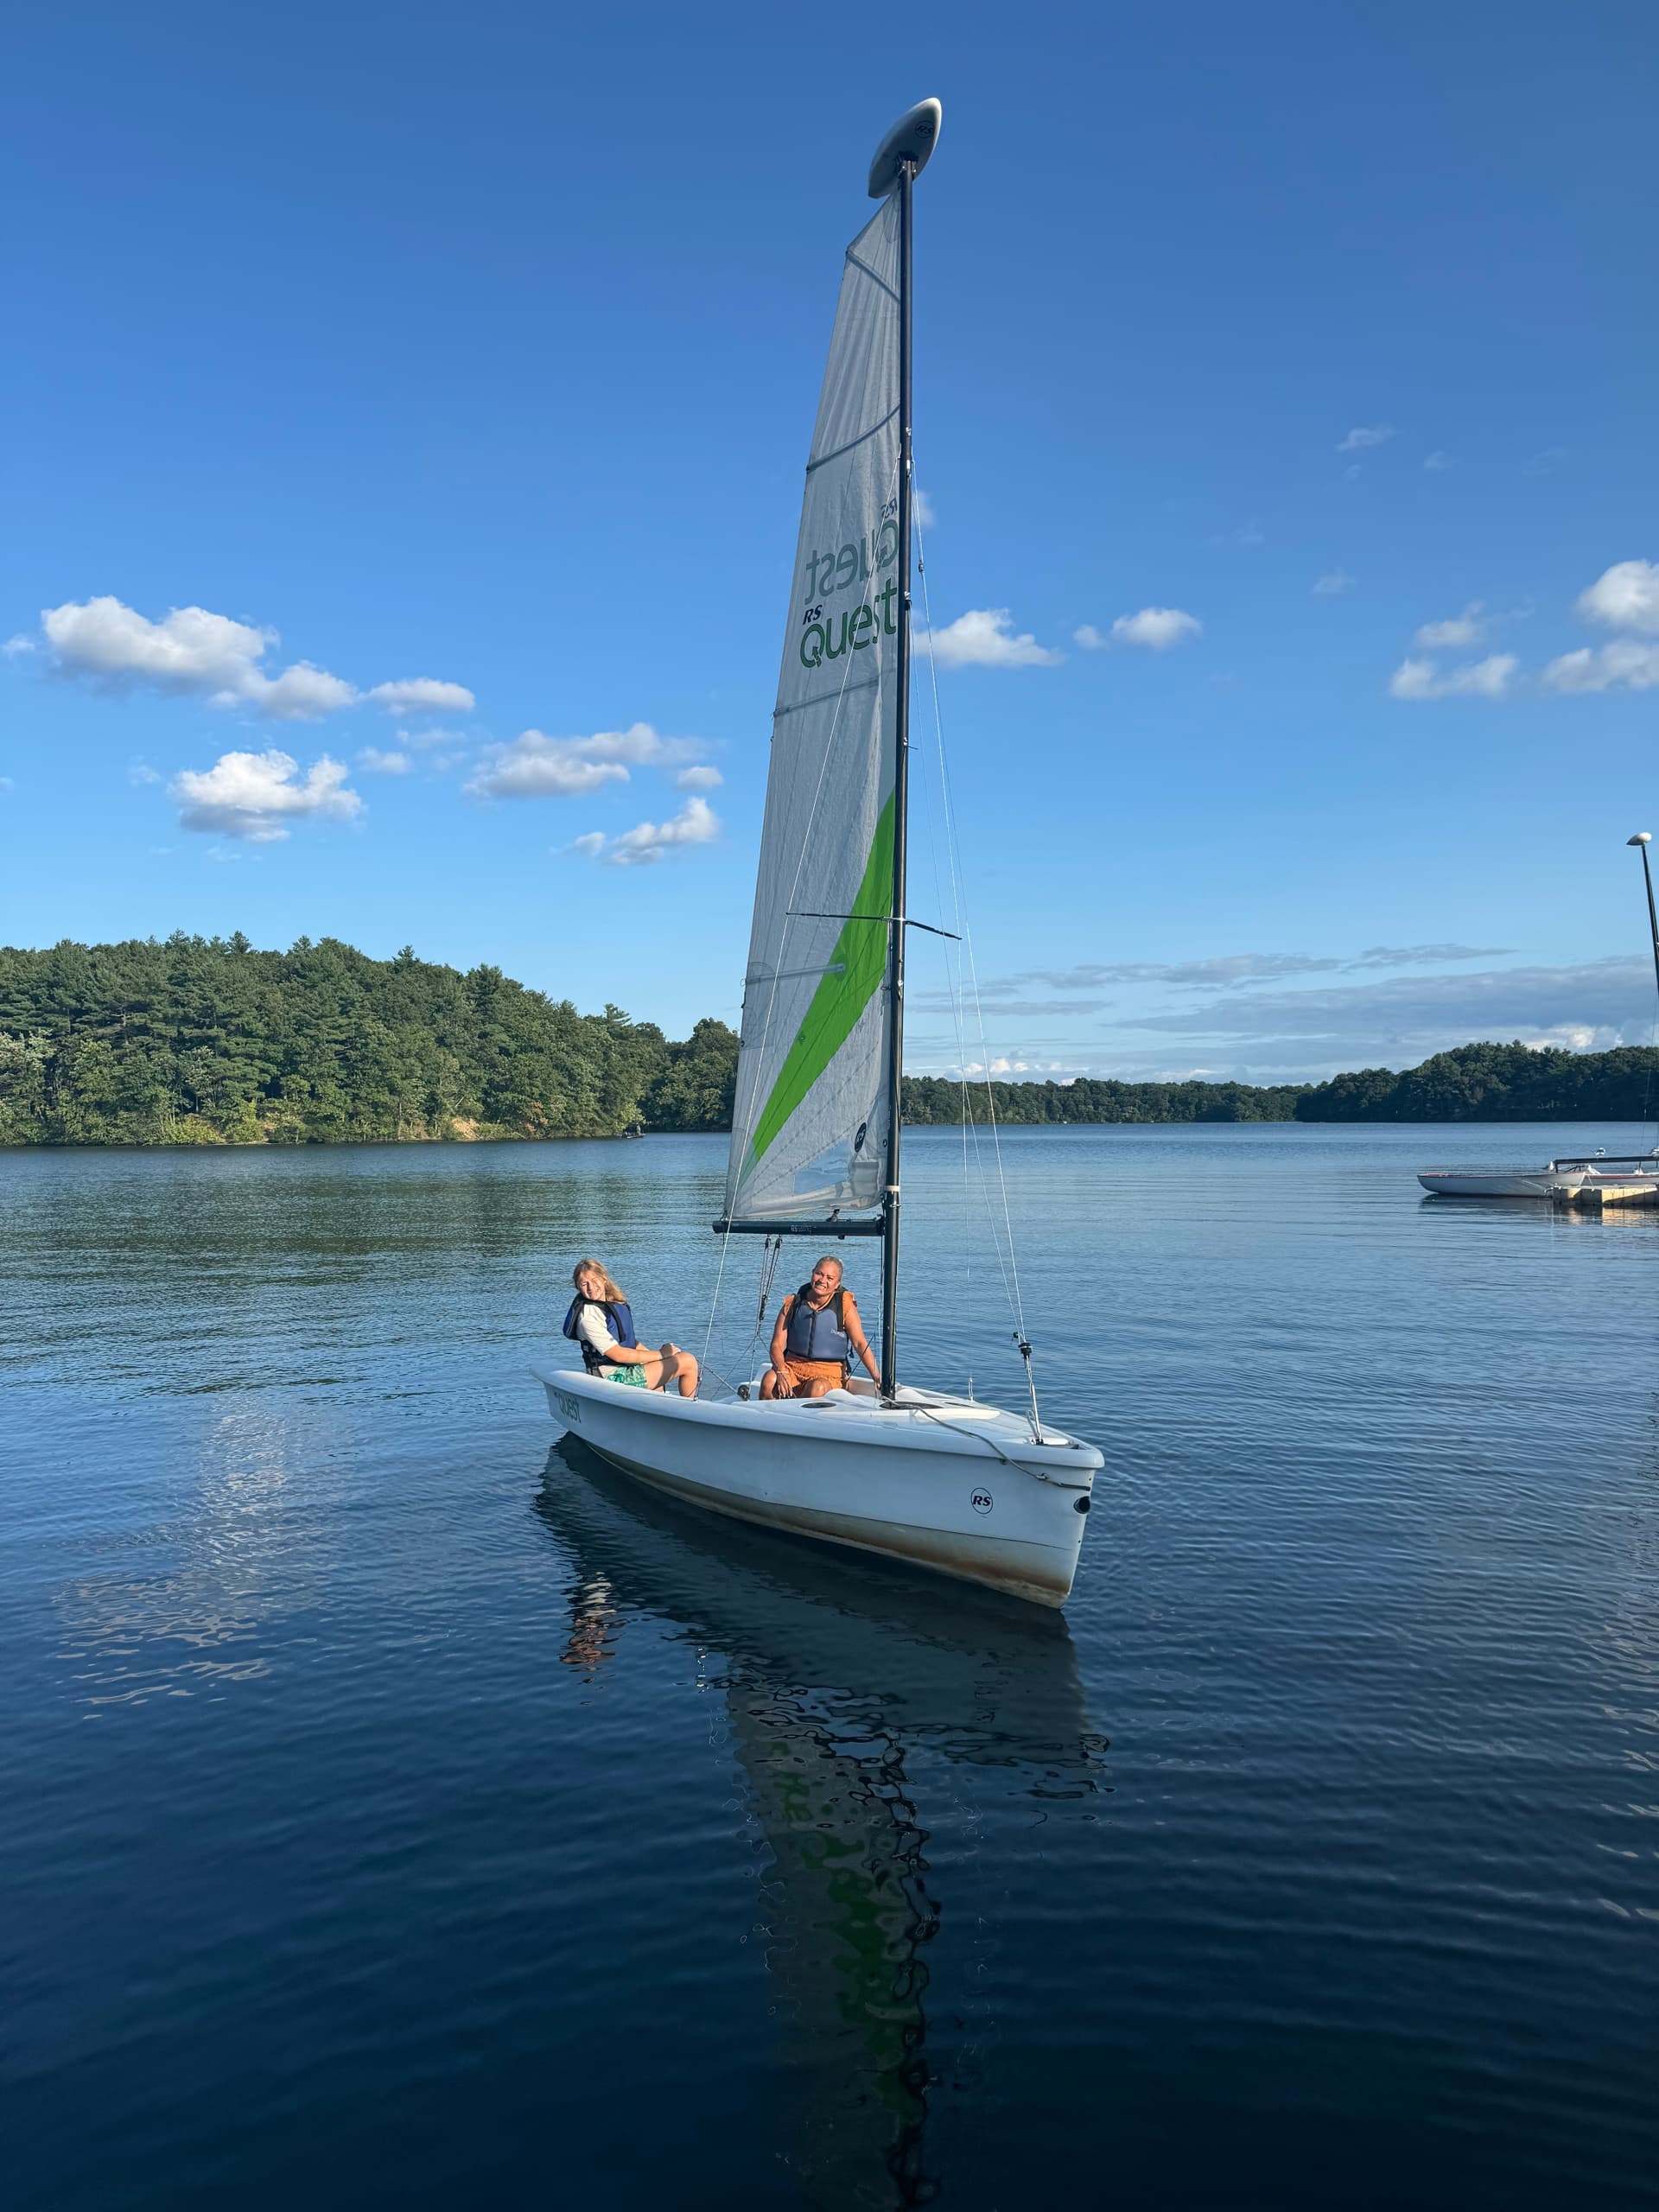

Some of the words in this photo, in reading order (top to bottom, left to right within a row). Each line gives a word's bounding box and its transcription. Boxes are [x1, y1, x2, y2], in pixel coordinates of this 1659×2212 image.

[917, 124, 934, 136] RS
[800, 577, 898, 669] Quest
[803, 604, 823, 626] RS
[973, 1495, 991, 1507] RS
